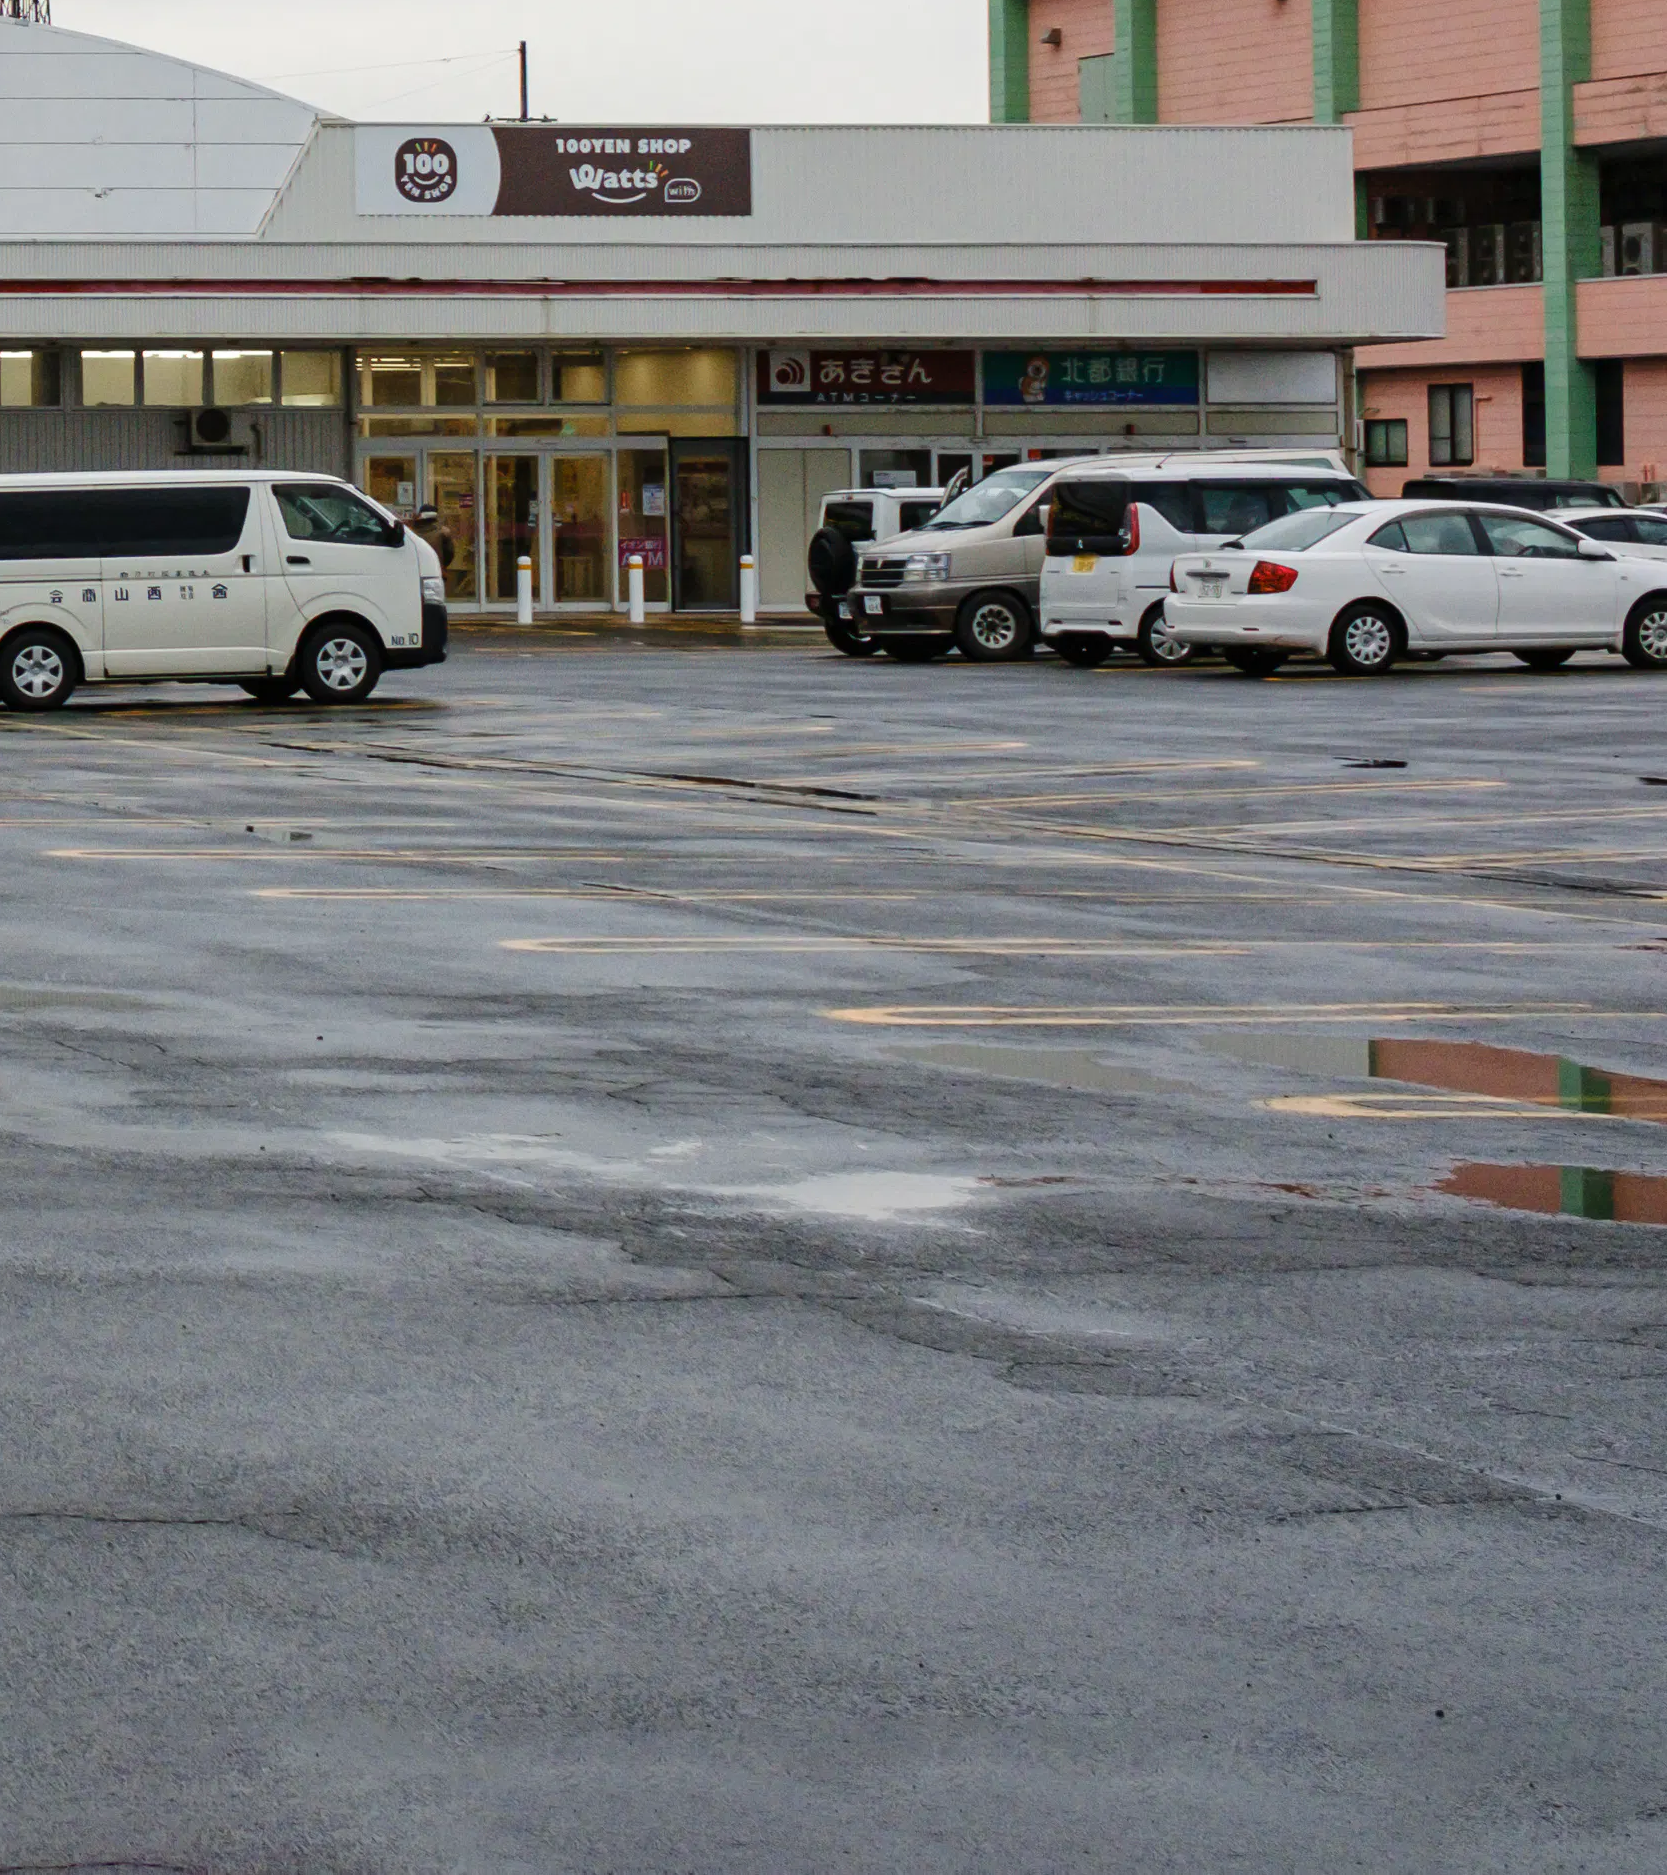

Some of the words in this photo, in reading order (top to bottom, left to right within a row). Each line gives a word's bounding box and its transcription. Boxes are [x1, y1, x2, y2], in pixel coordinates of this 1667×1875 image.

[556, 138, 631, 154] 100YEN
[637, 138, 691, 154] SHOP
[402, 153, 449, 174] 100
[424, 175, 453, 200] SHOP
[569, 163, 658, 190] Watts
[668, 185, 696, 196] with
[1059, 357, 1165, 383] 北都銀行
